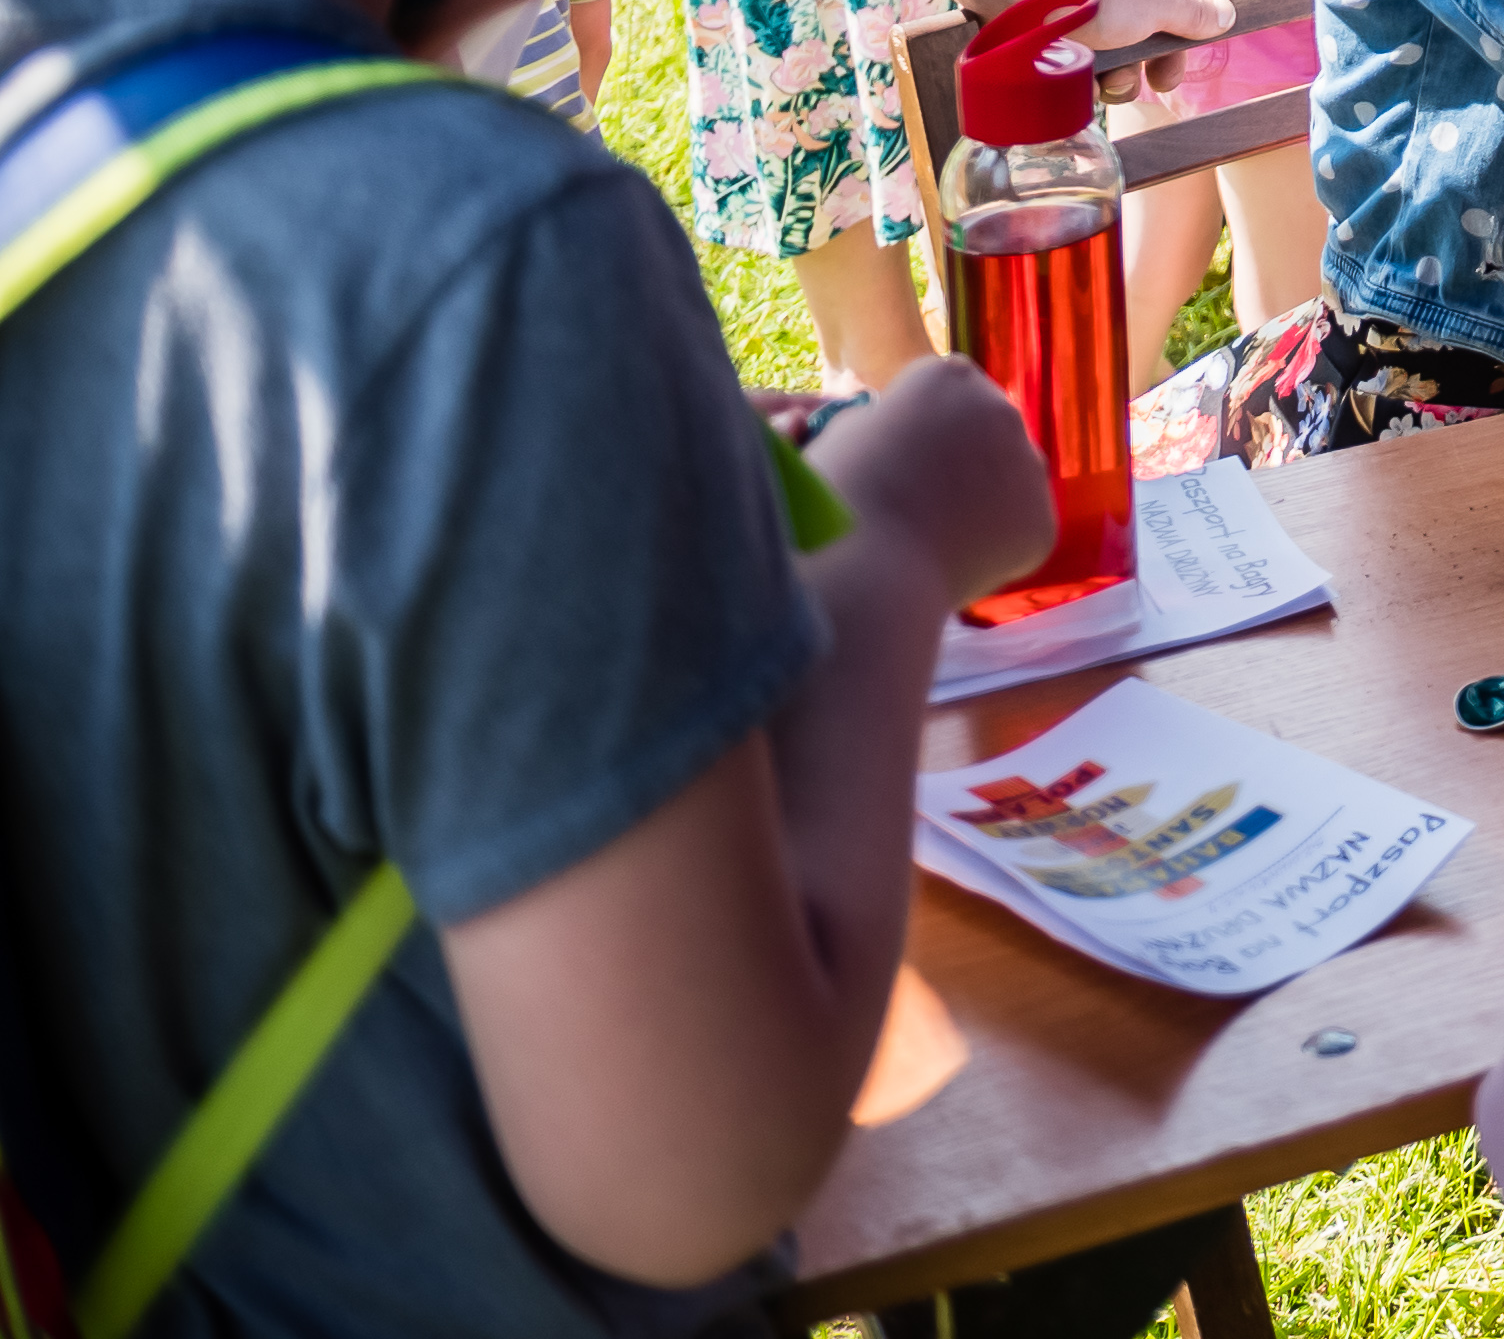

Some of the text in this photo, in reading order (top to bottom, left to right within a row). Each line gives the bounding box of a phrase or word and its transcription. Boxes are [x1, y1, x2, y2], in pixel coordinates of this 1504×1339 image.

[1139, 499, 1188, 550] NAZWA
[1180, 466, 1247, 540] Paszport
[1217, 543, 1247, 561] na
[1259, 830, 1371, 910] NAZWA
[1291, 811, 1448, 938] Paszport
